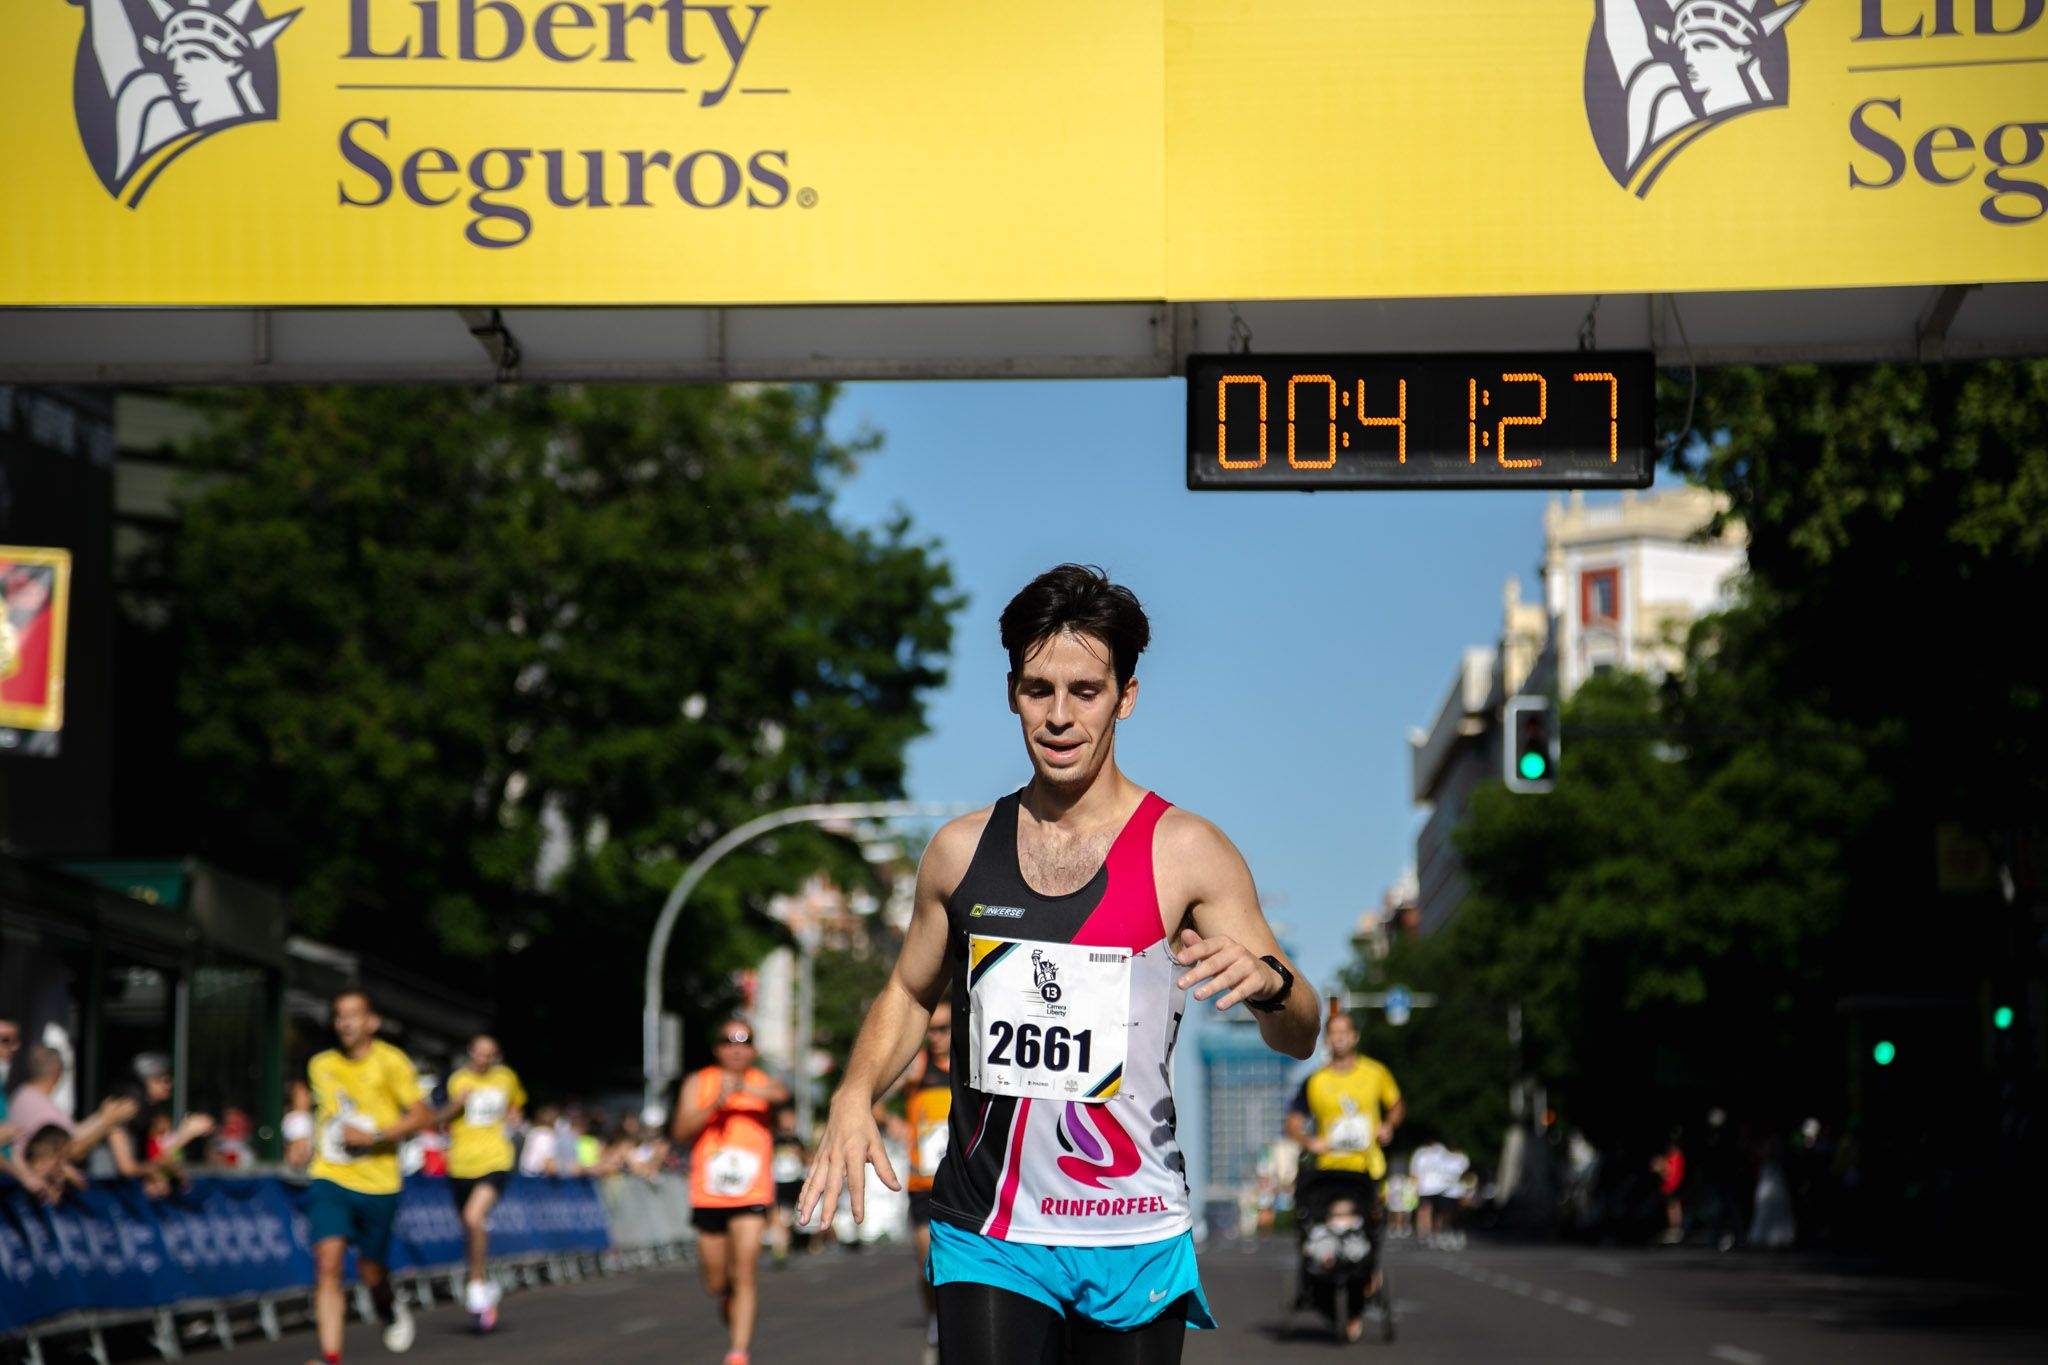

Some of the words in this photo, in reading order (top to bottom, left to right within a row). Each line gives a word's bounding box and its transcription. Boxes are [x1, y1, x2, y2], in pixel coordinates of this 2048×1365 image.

[985, 907, 1023, 917] INVERSE
[1045, 986, 1058, 999] 13
[1046, 1003, 1067, 1011] Carrera
[1046, 1009, 1067, 1018] Liberty
[987, 1020, 1092, 1074] 2661
[1040, 1195, 1168, 1218] RUNFORFEEL
